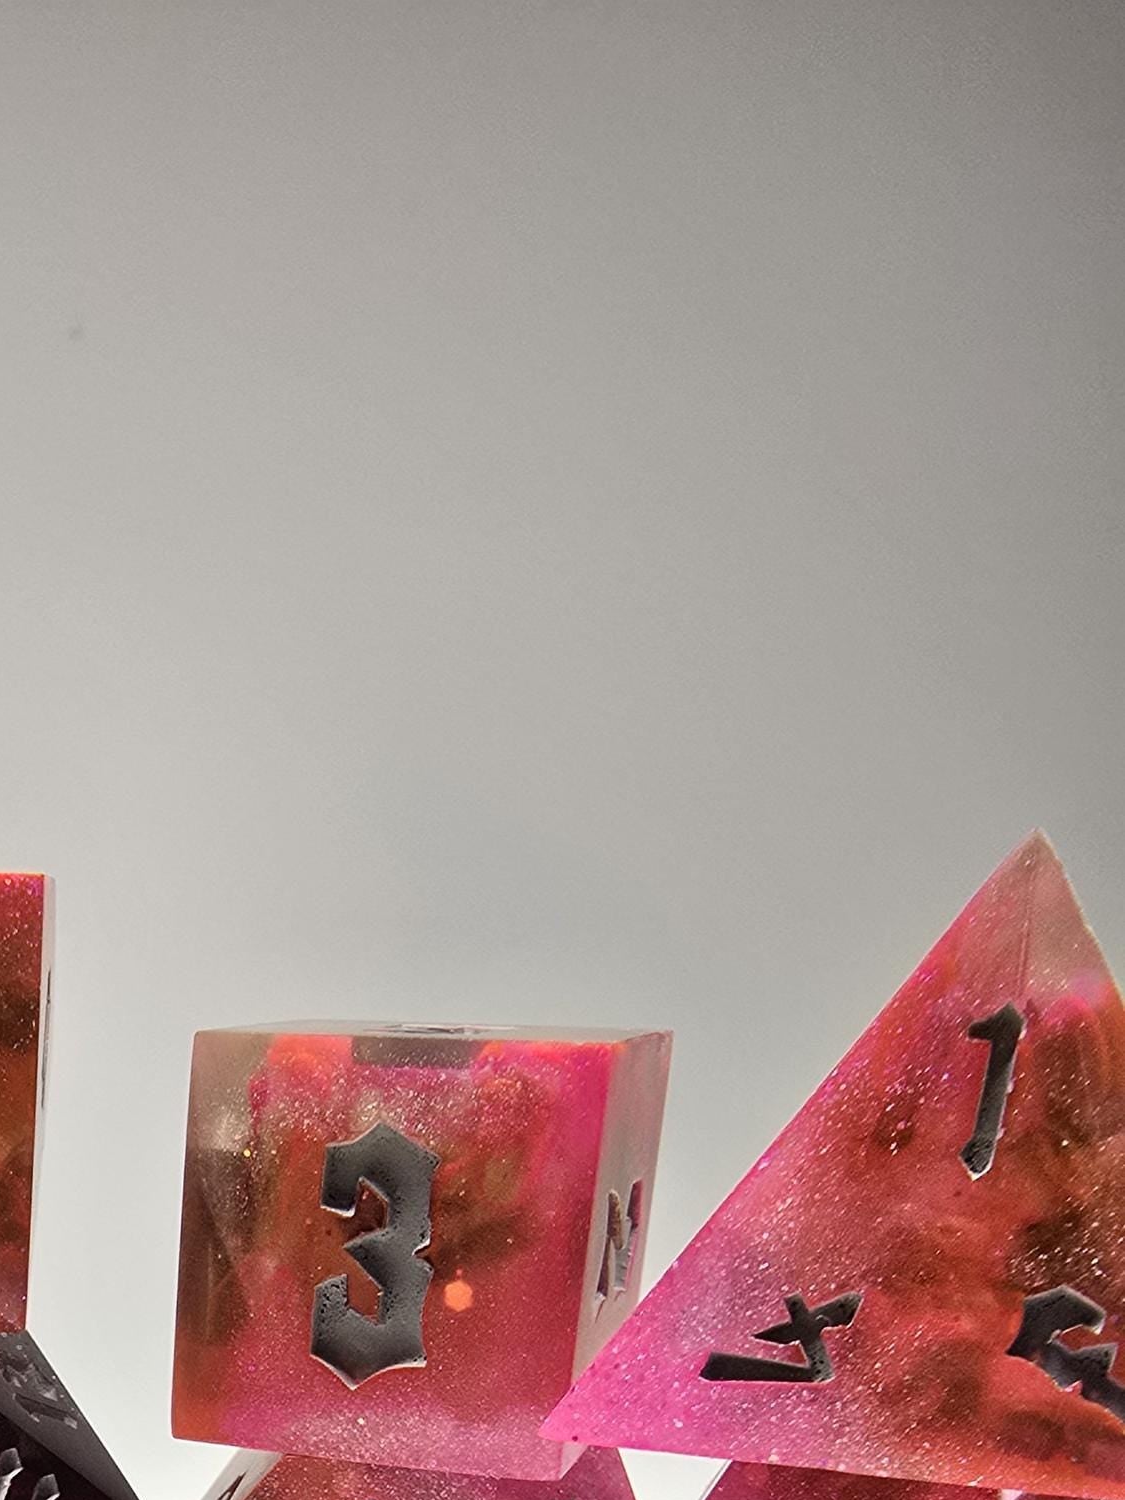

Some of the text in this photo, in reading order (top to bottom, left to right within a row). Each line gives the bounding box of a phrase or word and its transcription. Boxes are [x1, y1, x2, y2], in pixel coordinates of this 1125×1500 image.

[960, 1003, 1026, 1181] 1
[310, 1122, 442, 1390] 3
[699, 1294, 864, 1383] 4
